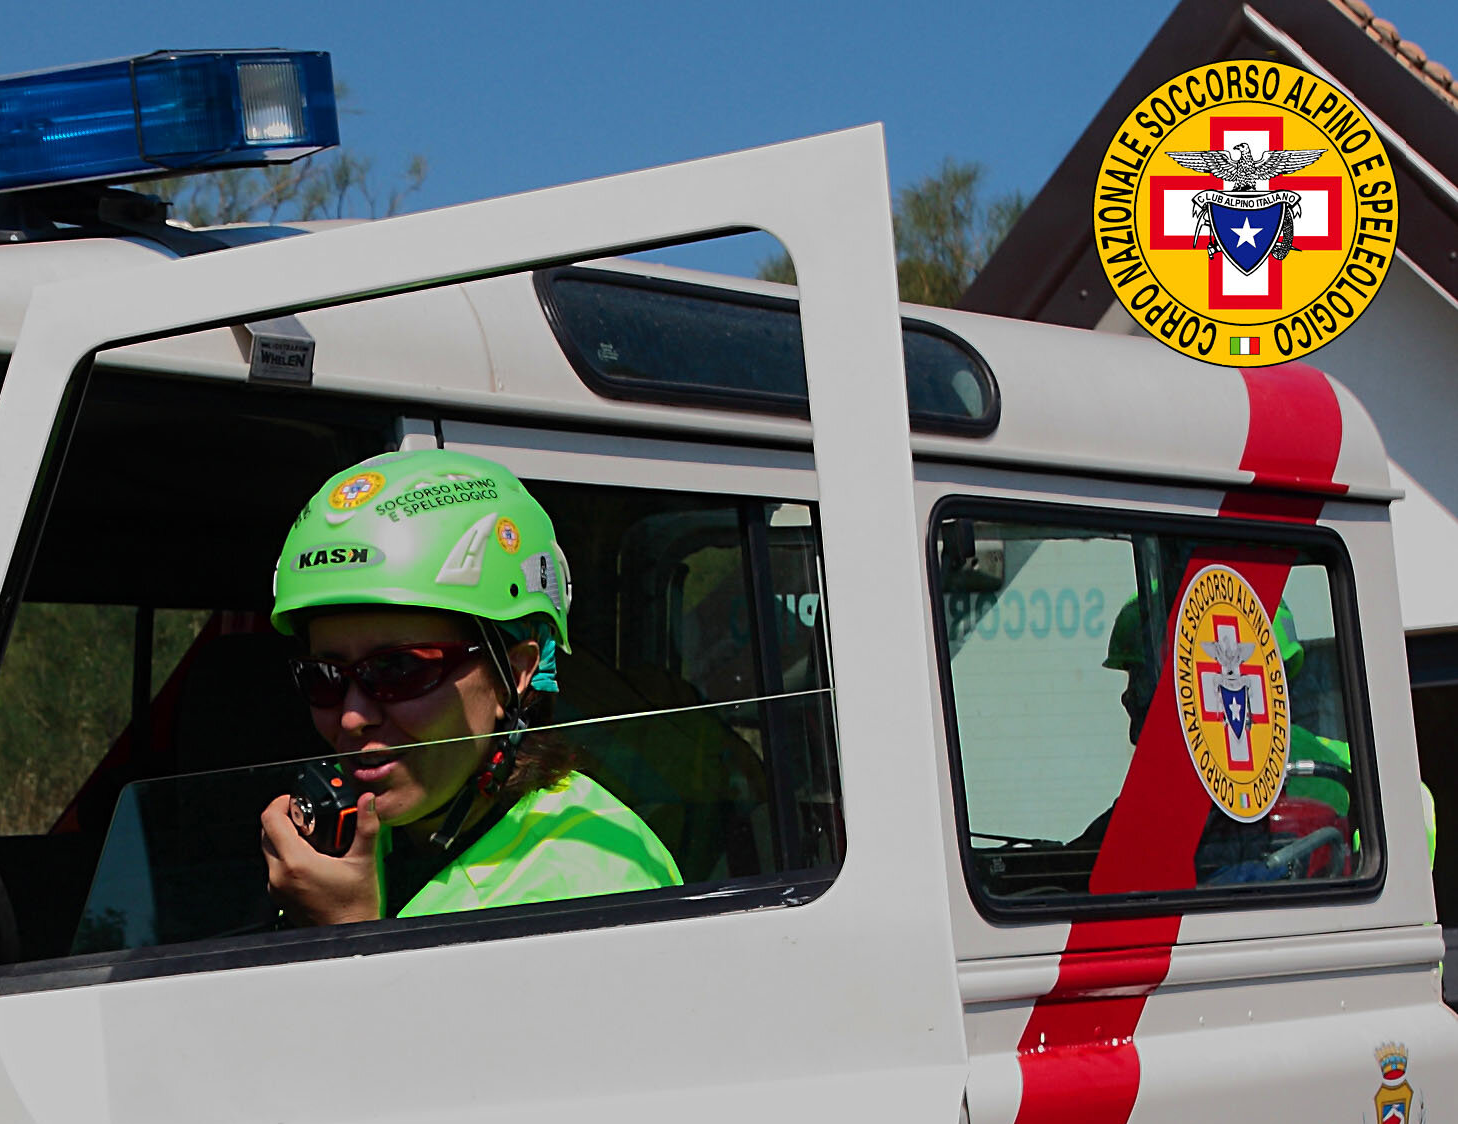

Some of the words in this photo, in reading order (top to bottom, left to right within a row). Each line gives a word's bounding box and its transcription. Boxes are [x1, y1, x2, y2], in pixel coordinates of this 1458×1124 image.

[375, 483, 451, 516] SOCCORSO
[453, 478, 497, 492] ALPINO
[388, 511, 400, 523] E
[403, 488, 498, 517] SPELEOLOGICO
[299, 548, 368, 569] KASK
[1185, 573, 1234, 630] SOCCORSO
[1236, 584, 1271, 647] ALPINO
[1266, 649, 1277, 665] E
[1179, 625, 1202, 752] NAZIONALE
[1253, 669, 1286, 809] SPELEOLOGICO
[1199, 750, 1234, 809] CORPO
